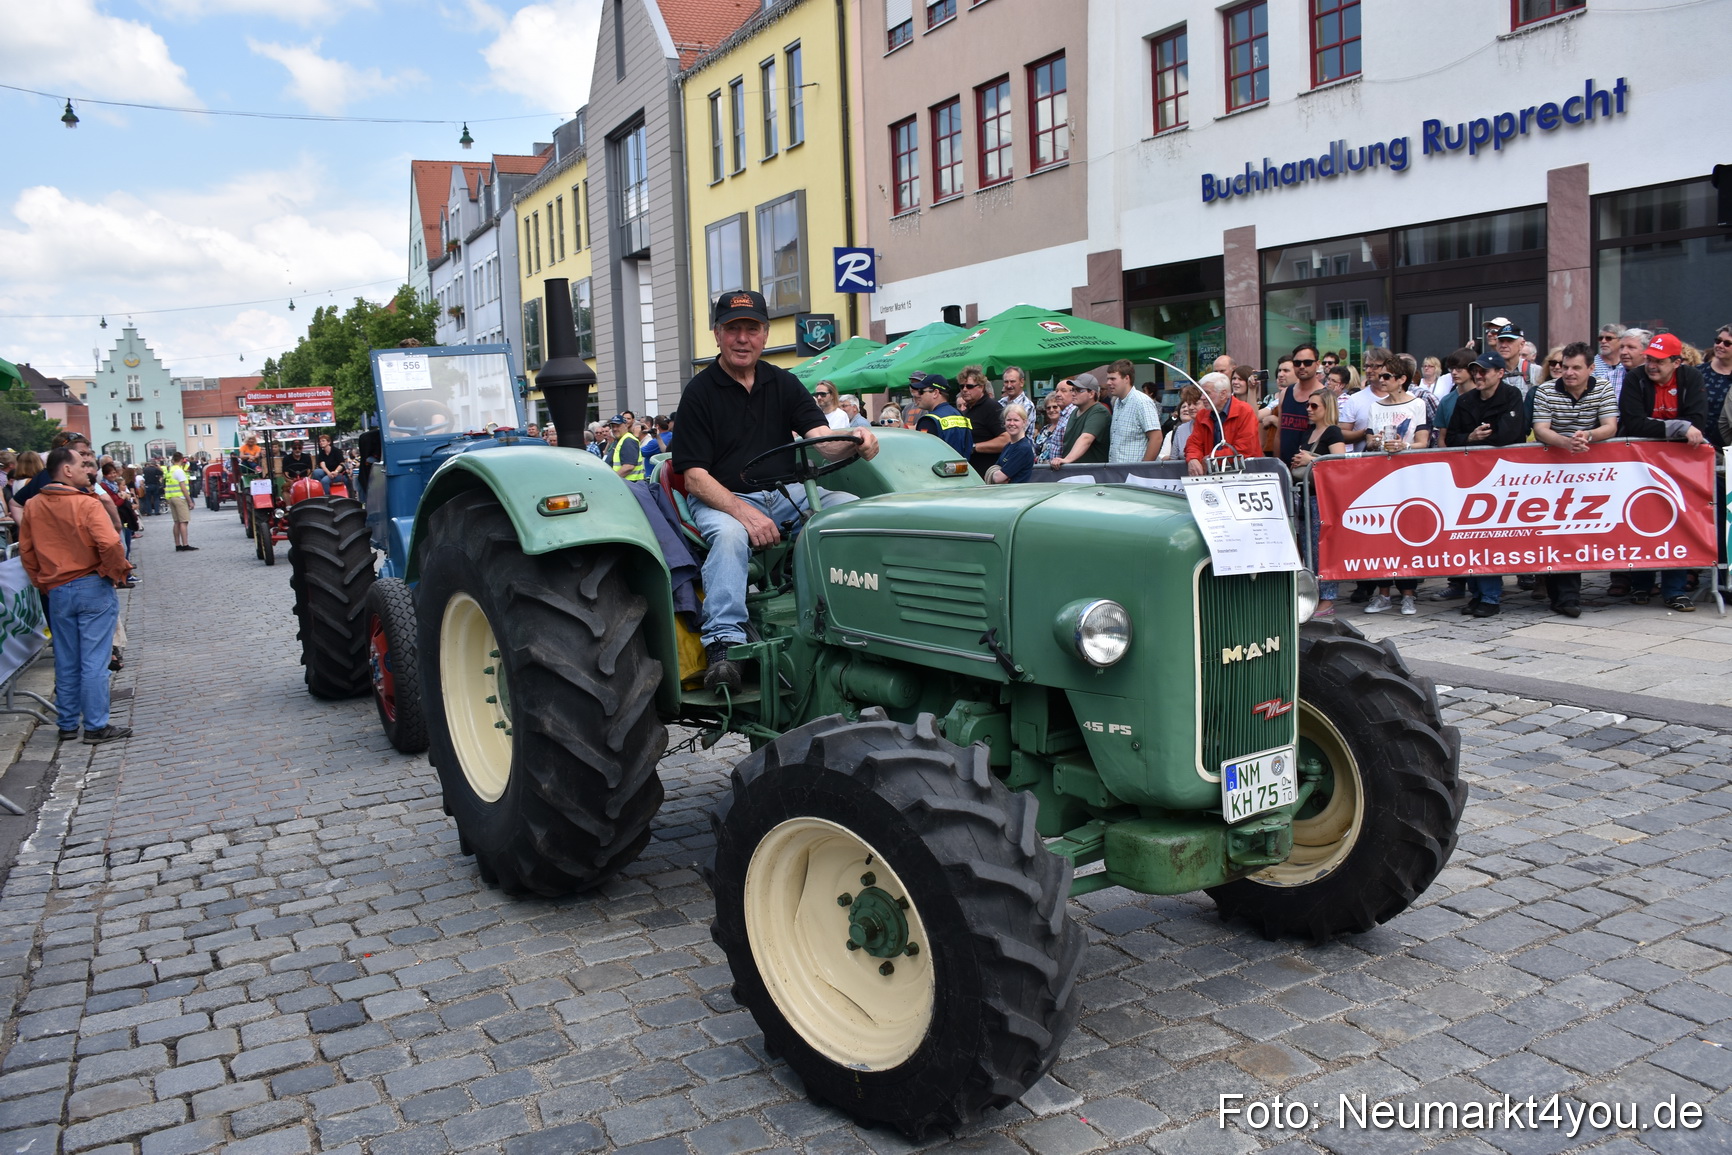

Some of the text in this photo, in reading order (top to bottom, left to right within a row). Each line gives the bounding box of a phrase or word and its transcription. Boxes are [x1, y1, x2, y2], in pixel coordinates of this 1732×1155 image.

[1201, 77, 1629, 203] Buchhandlung Rupprecht
[895, 301, 906, 311] Markt
[906, 300, 912, 309] 15
[403, 361, 421, 370] 556
[288, 390, 331, 399] Motorsportclub
[1492, 467, 1618, 487] Autoklassik
[1238, 491, 1274, 513] 555
[1455, 488, 1611, 526] Dietz
[1450, 528, 1533, 540] BREITENBRUNN
[1344, 542, 1688, 572] www.autoklassik-dietz.de
[1083, 721, 1132, 735] 45 PS
[1238, 761, 1260, 790] NM
[1231, 783, 1279, 818] KH 75
